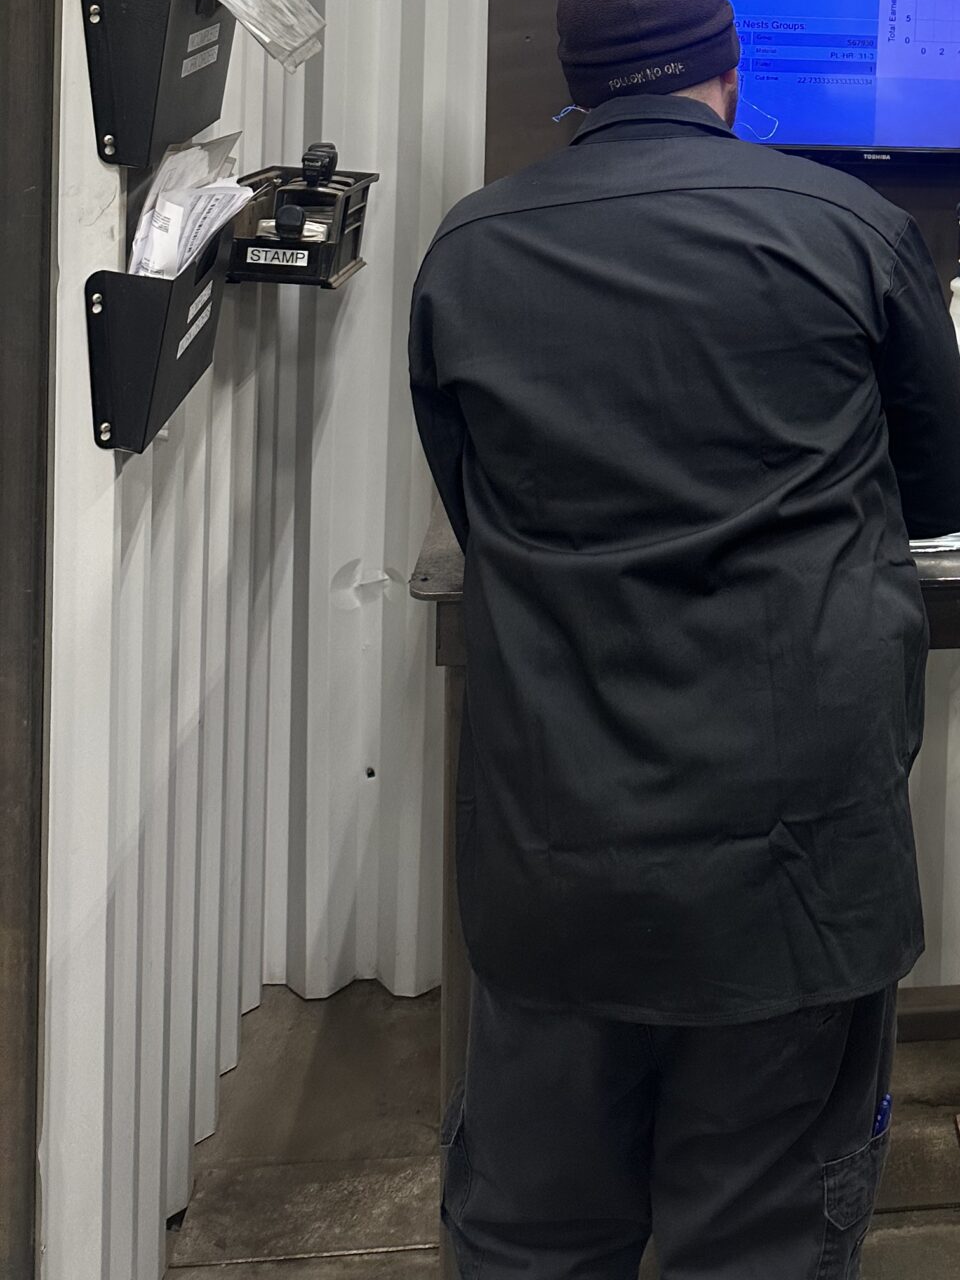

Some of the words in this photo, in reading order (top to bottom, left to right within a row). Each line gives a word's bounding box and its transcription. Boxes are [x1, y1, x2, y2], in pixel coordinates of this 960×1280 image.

[743, 21, 769, 29] Nests
[888, 26, 896, 42] Total
[905, 37, 910, 45] 0
[939, 48, 944, 56] 2
[608, 72, 646, 91] FOLLOW
[646, 67, 661, 81] NO
[664, 62, 685, 75] ONE
[250, 249, 306, 264] STAMP
